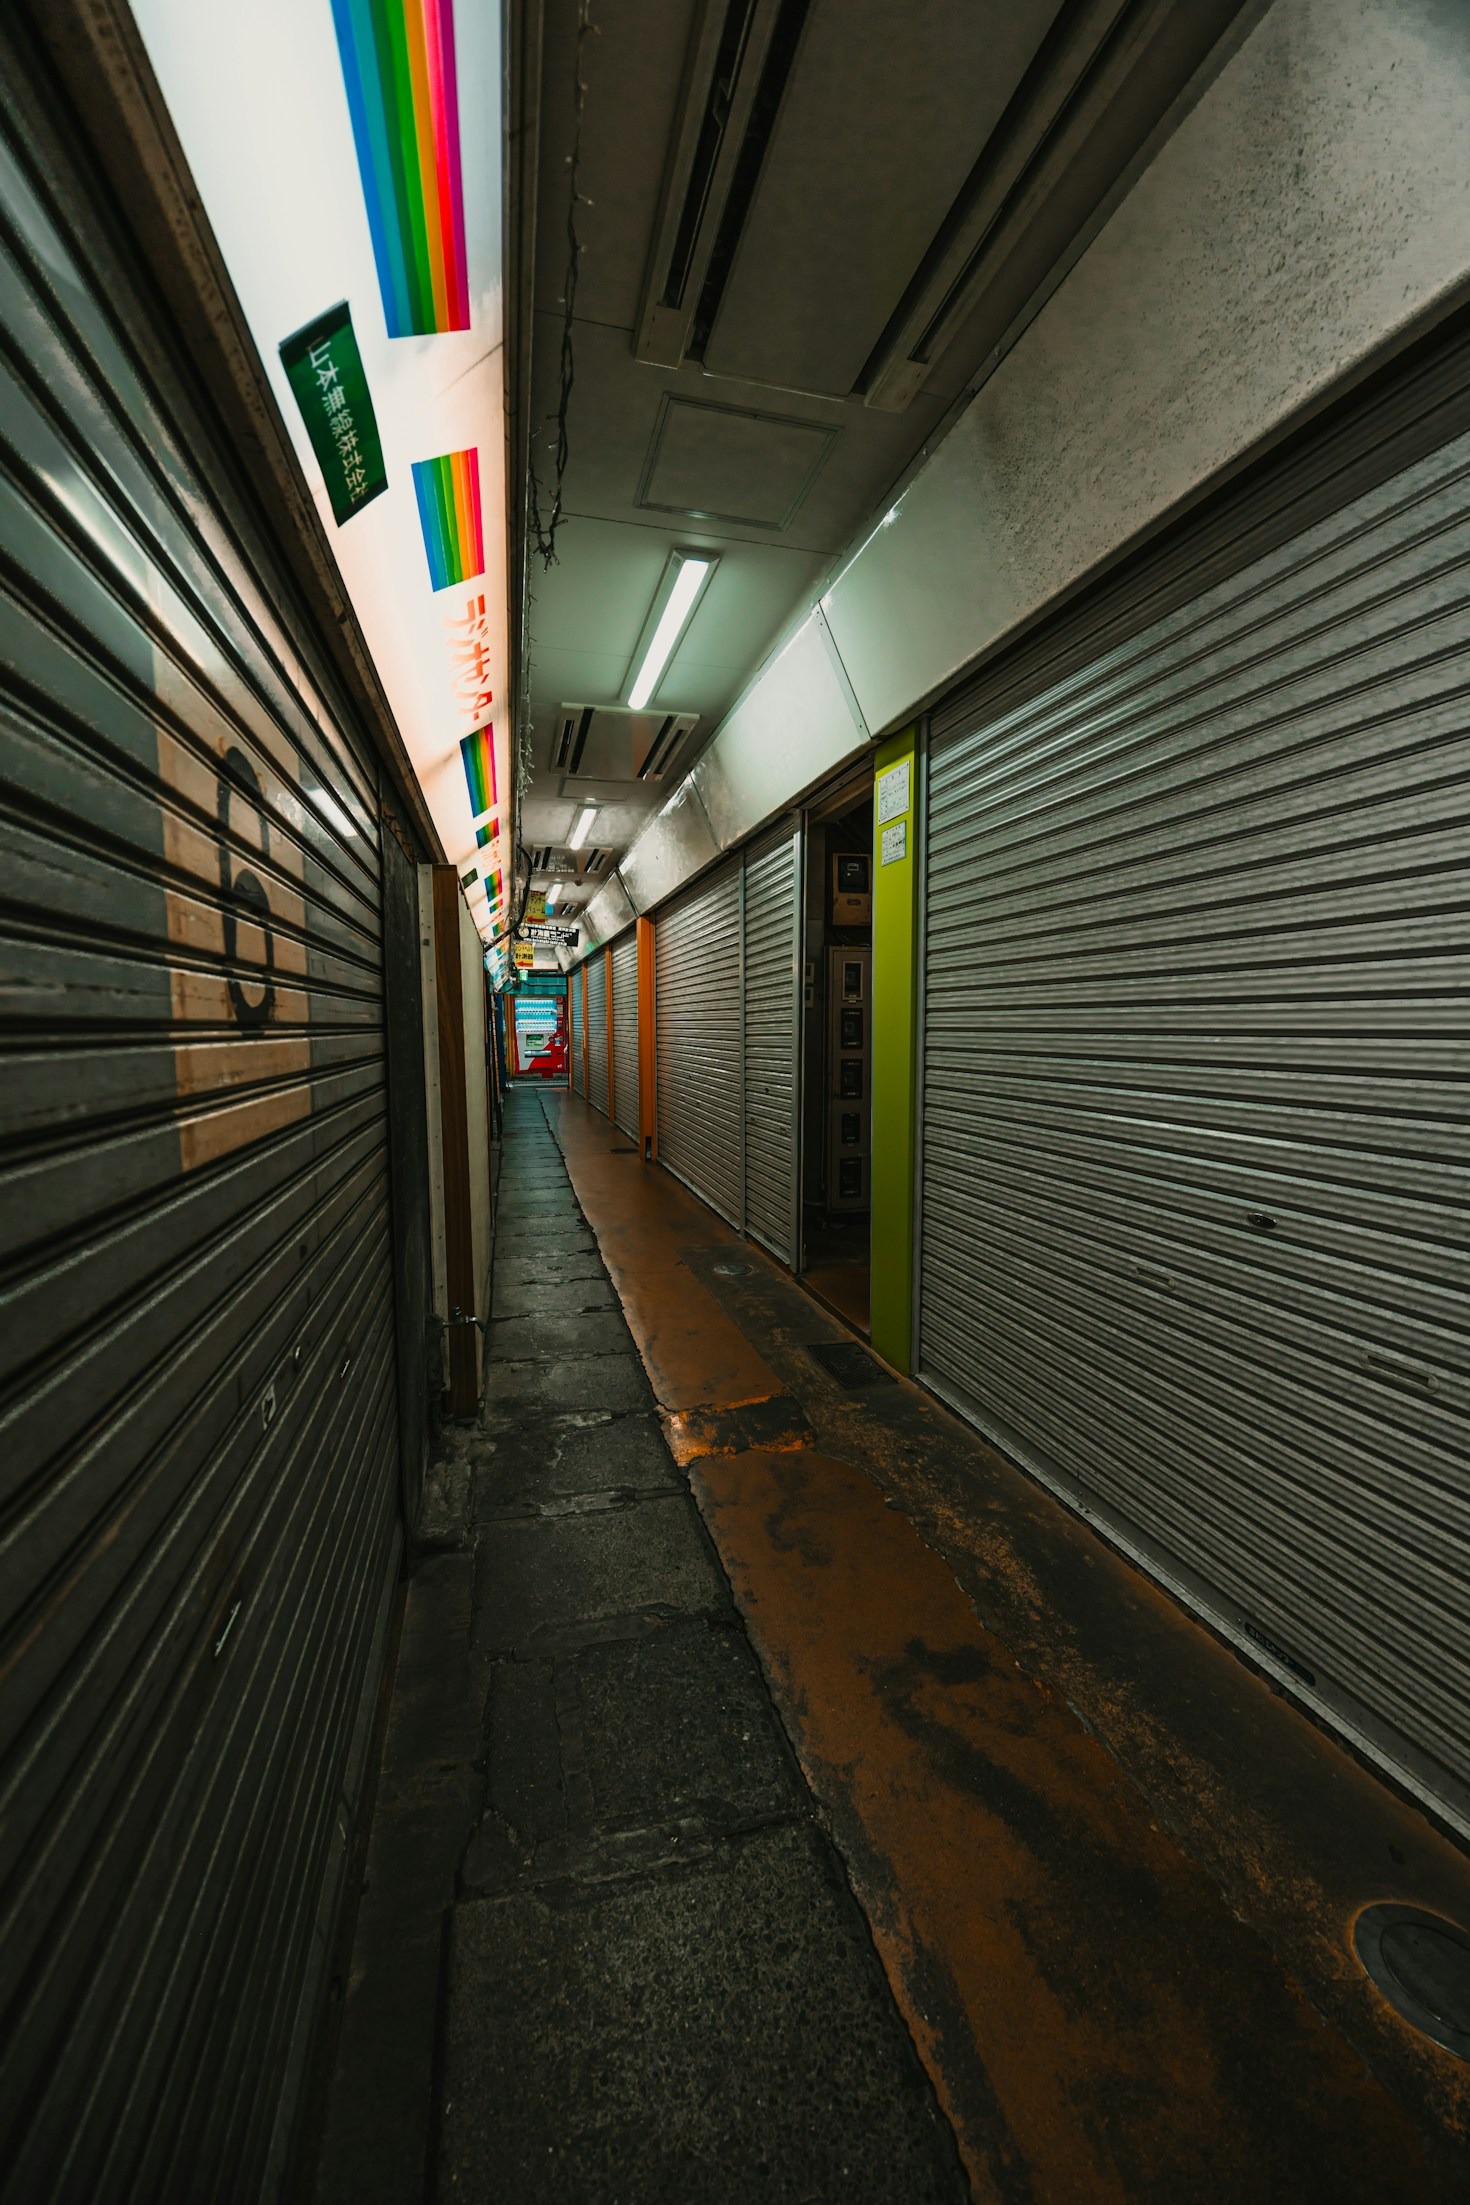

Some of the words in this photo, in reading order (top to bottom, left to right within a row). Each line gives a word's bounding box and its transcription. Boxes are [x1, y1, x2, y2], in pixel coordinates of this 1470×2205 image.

[306, 336, 369, 504] 山本無線株式会社
[442, 594, 492, 721] ラジオセンター
